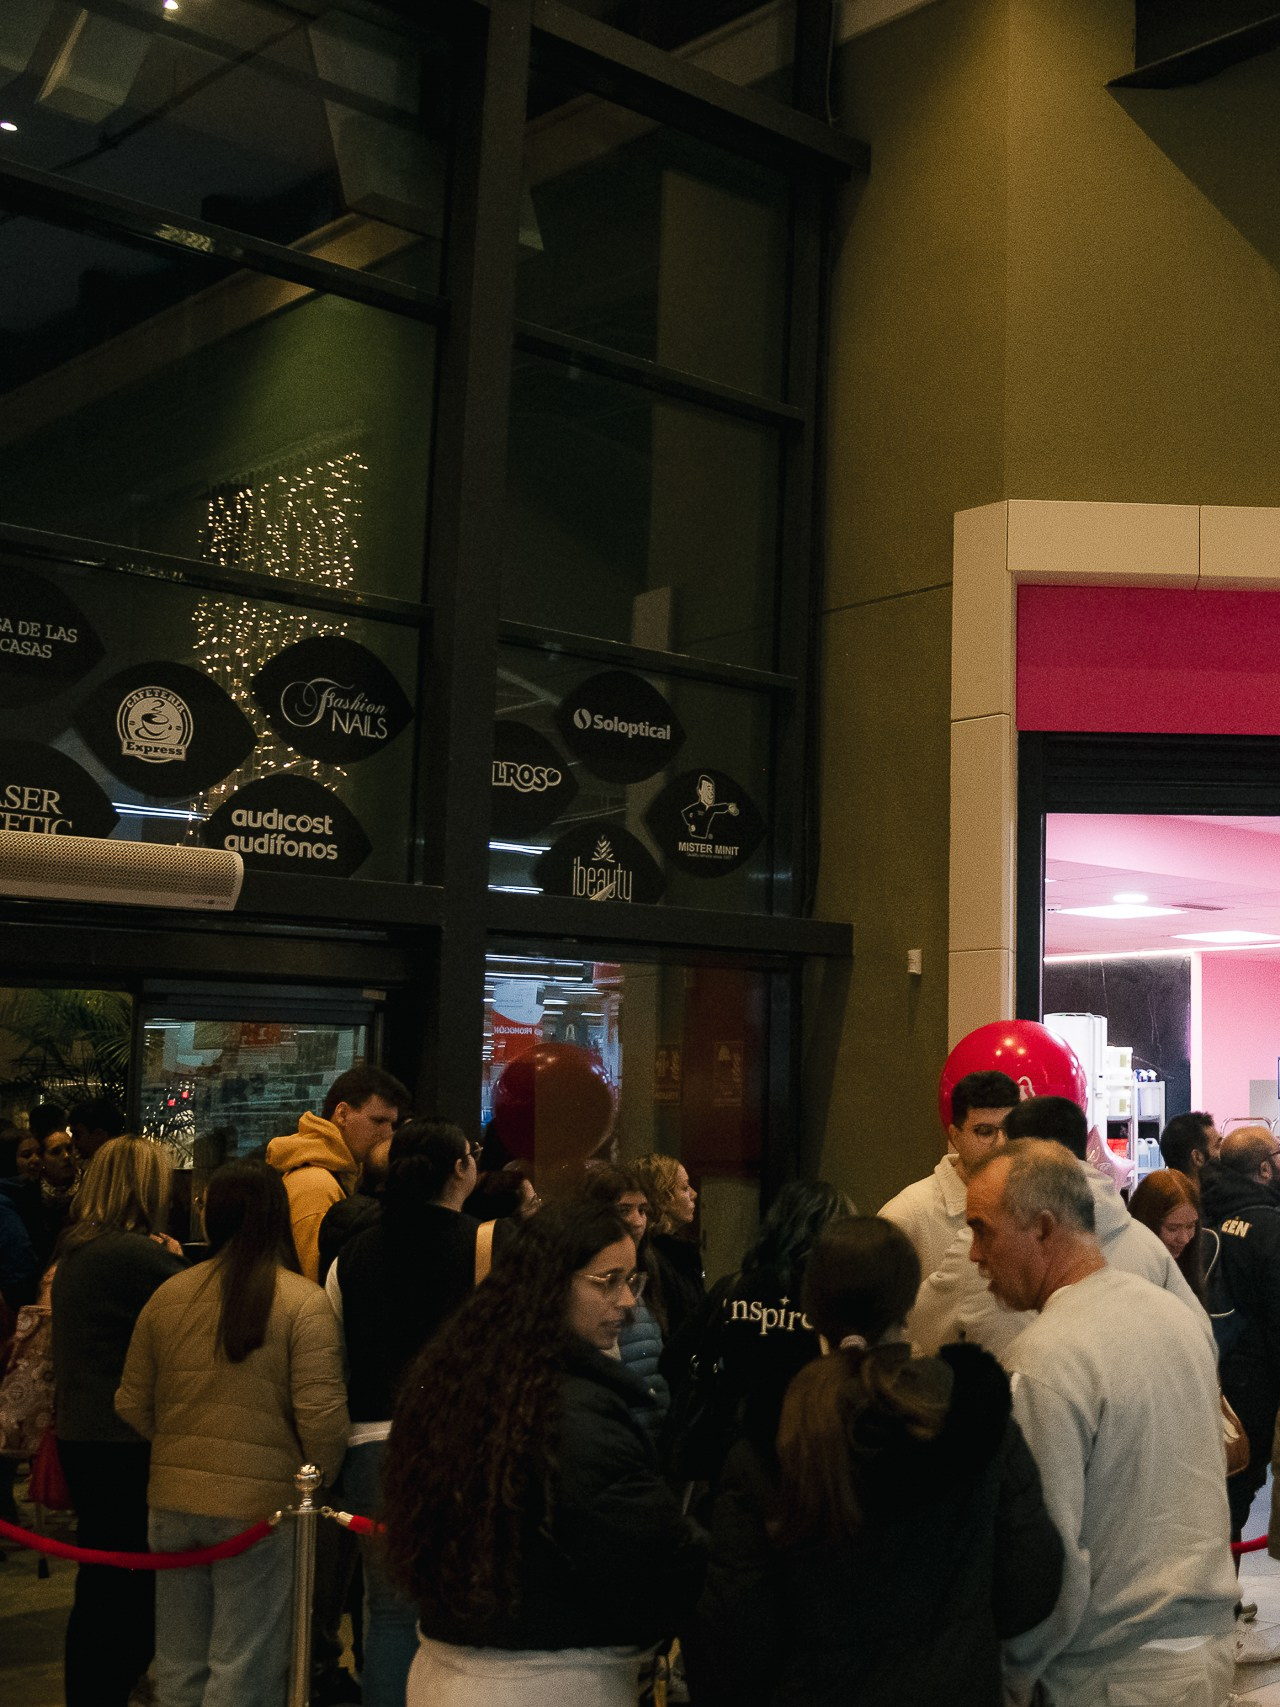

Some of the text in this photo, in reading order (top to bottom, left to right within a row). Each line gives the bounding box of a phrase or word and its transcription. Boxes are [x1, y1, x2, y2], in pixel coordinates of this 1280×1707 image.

[18, 620, 41, 637] DE
[45, 624, 78, 643] LAS
[0, 638, 53, 659] CASAS
[281, 677, 387, 728] Fashion
[331, 710, 388, 740] NAILS
[593, 714, 671, 740] Soloptical
[126, 741, 183, 755] Express
[0, 784, 63, 814] SER
[231, 808, 333, 835] audicost
[224, 833, 338, 860] audífonos
[678, 841, 740, 856] MISTER MINIT
[572, 856, 633, 903] ibeauty
